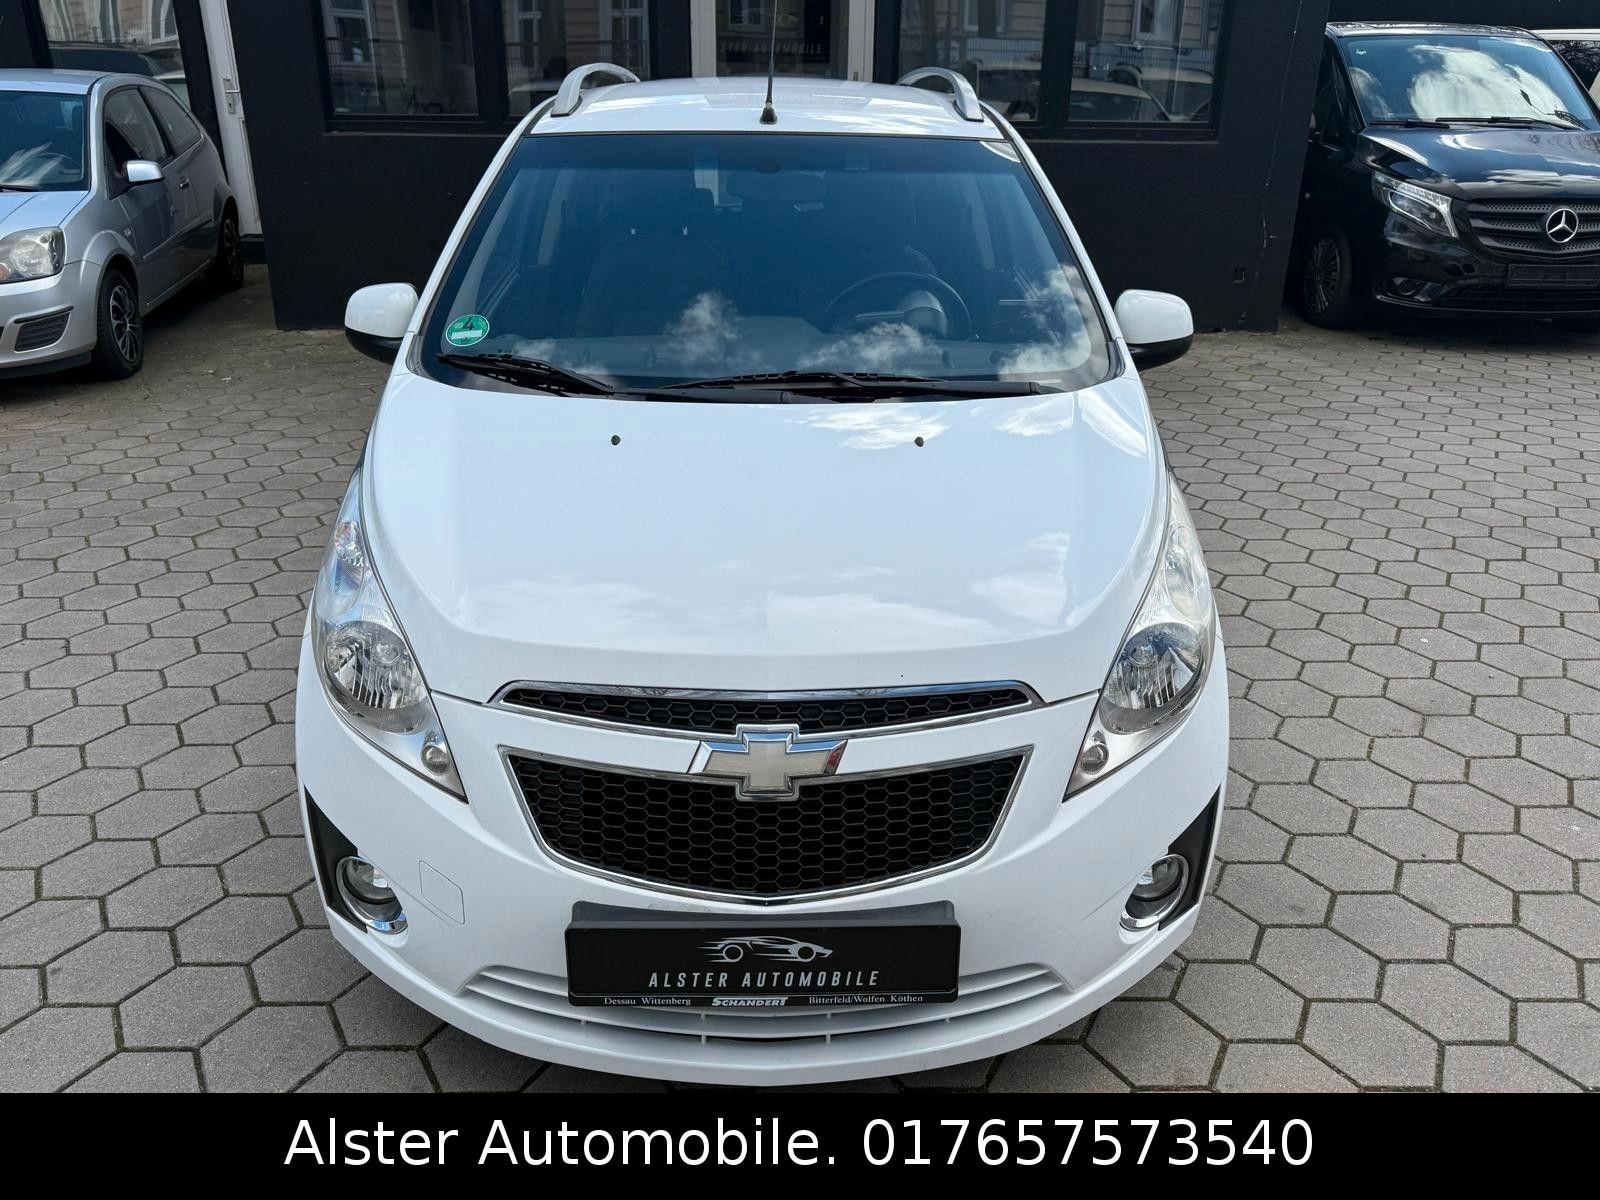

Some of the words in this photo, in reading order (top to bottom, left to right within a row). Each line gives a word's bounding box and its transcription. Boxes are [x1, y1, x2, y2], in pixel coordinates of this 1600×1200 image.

[753, 42, 824, 54] AUOMOBILE
[462, 316, 475, 330] 4
[648, 972, 729, 989] ALSTER
[741, 970, 881, 988] AUTOMOBILE
[604, 997, 637, 1006] Dessau
[641, 996, 692, 1007] Wittenberg
[711, 997, 788, 1008] SCHANDERT
[808, 994, 886, 1005] Bitterfeld/Wolfen
[890, 993, 924, 1004] Köthen
